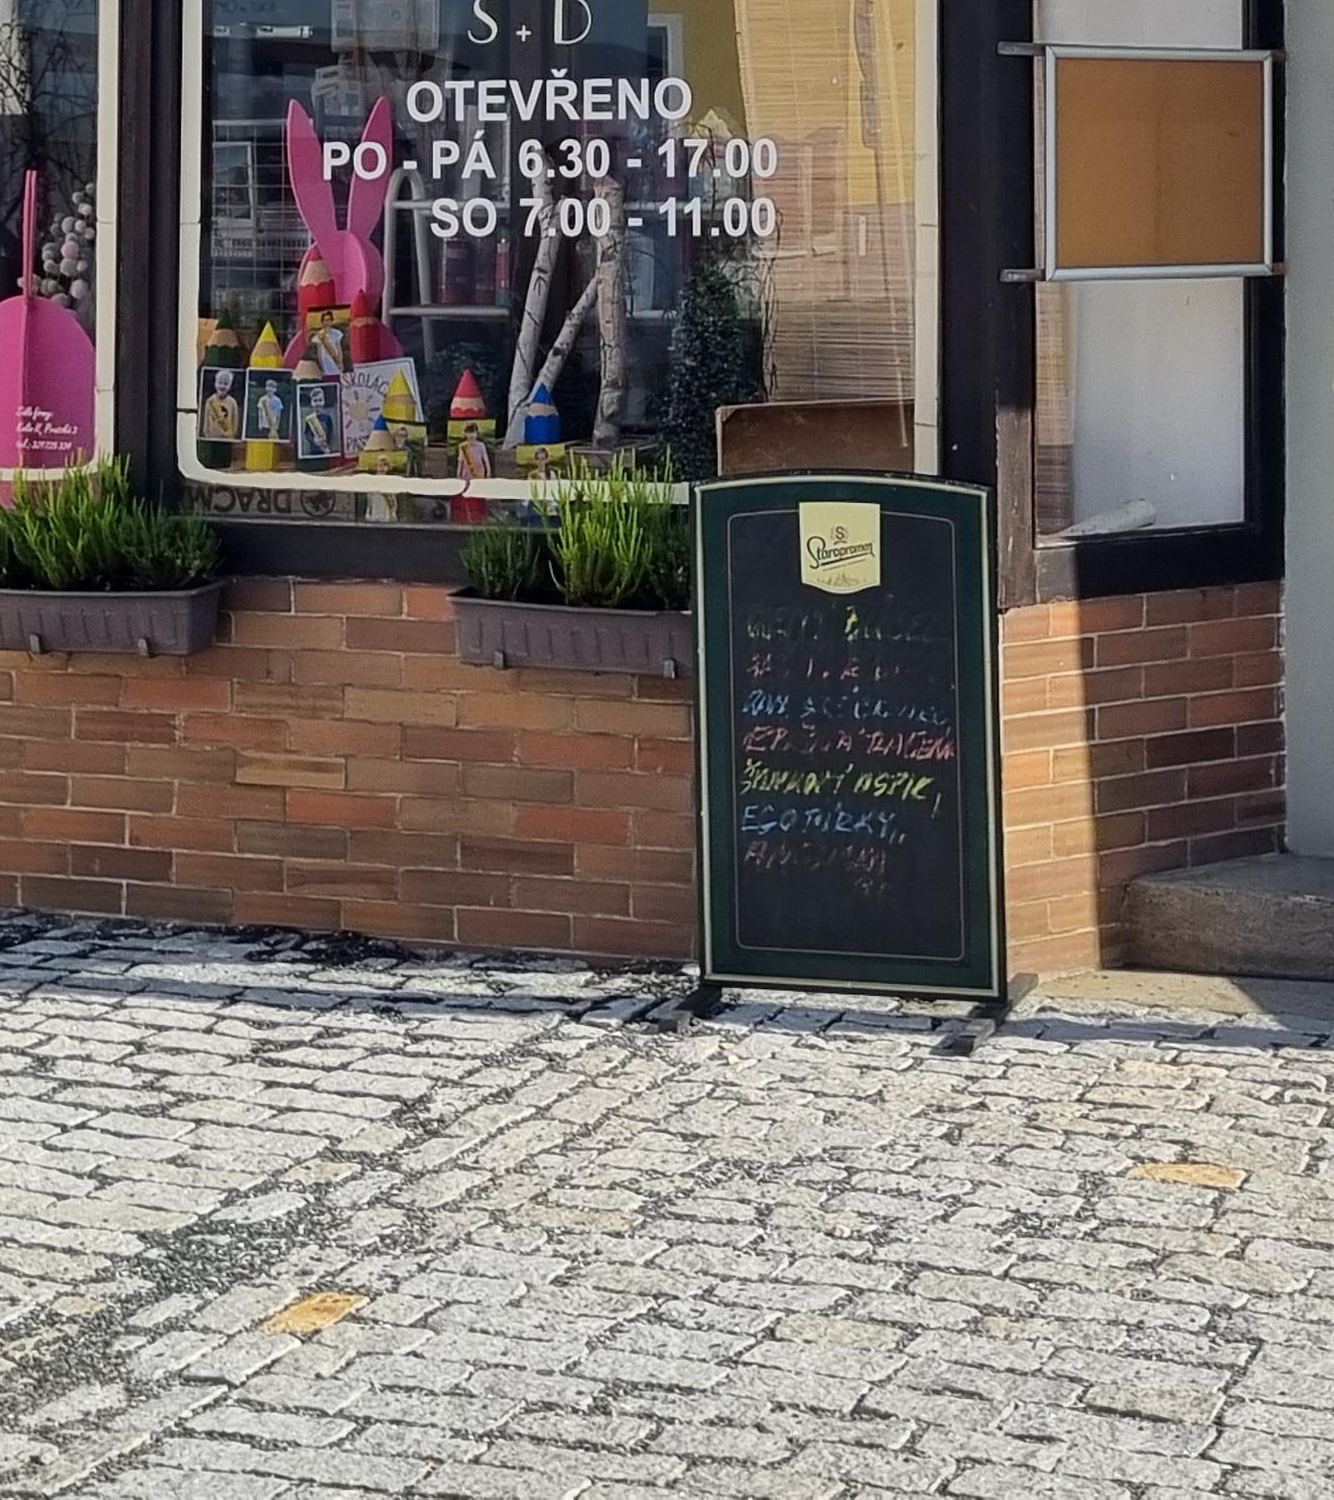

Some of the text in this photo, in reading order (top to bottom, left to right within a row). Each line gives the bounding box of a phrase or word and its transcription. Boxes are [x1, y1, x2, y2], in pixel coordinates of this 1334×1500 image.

[515, 23, 532, 43] +
[405, 68, 693, 123] OTEVŘENO
[322, 140, 388, 181] PO
[432, 130, 497, 179] PÁ
[518, 138, 611, 179] 6.30
[657, 138, 778, 178] 17.00
[430, 198, 498, 237] SO
[518, 198, 611, 237] 7.00
[658, 197, 776, 237] 11.00
